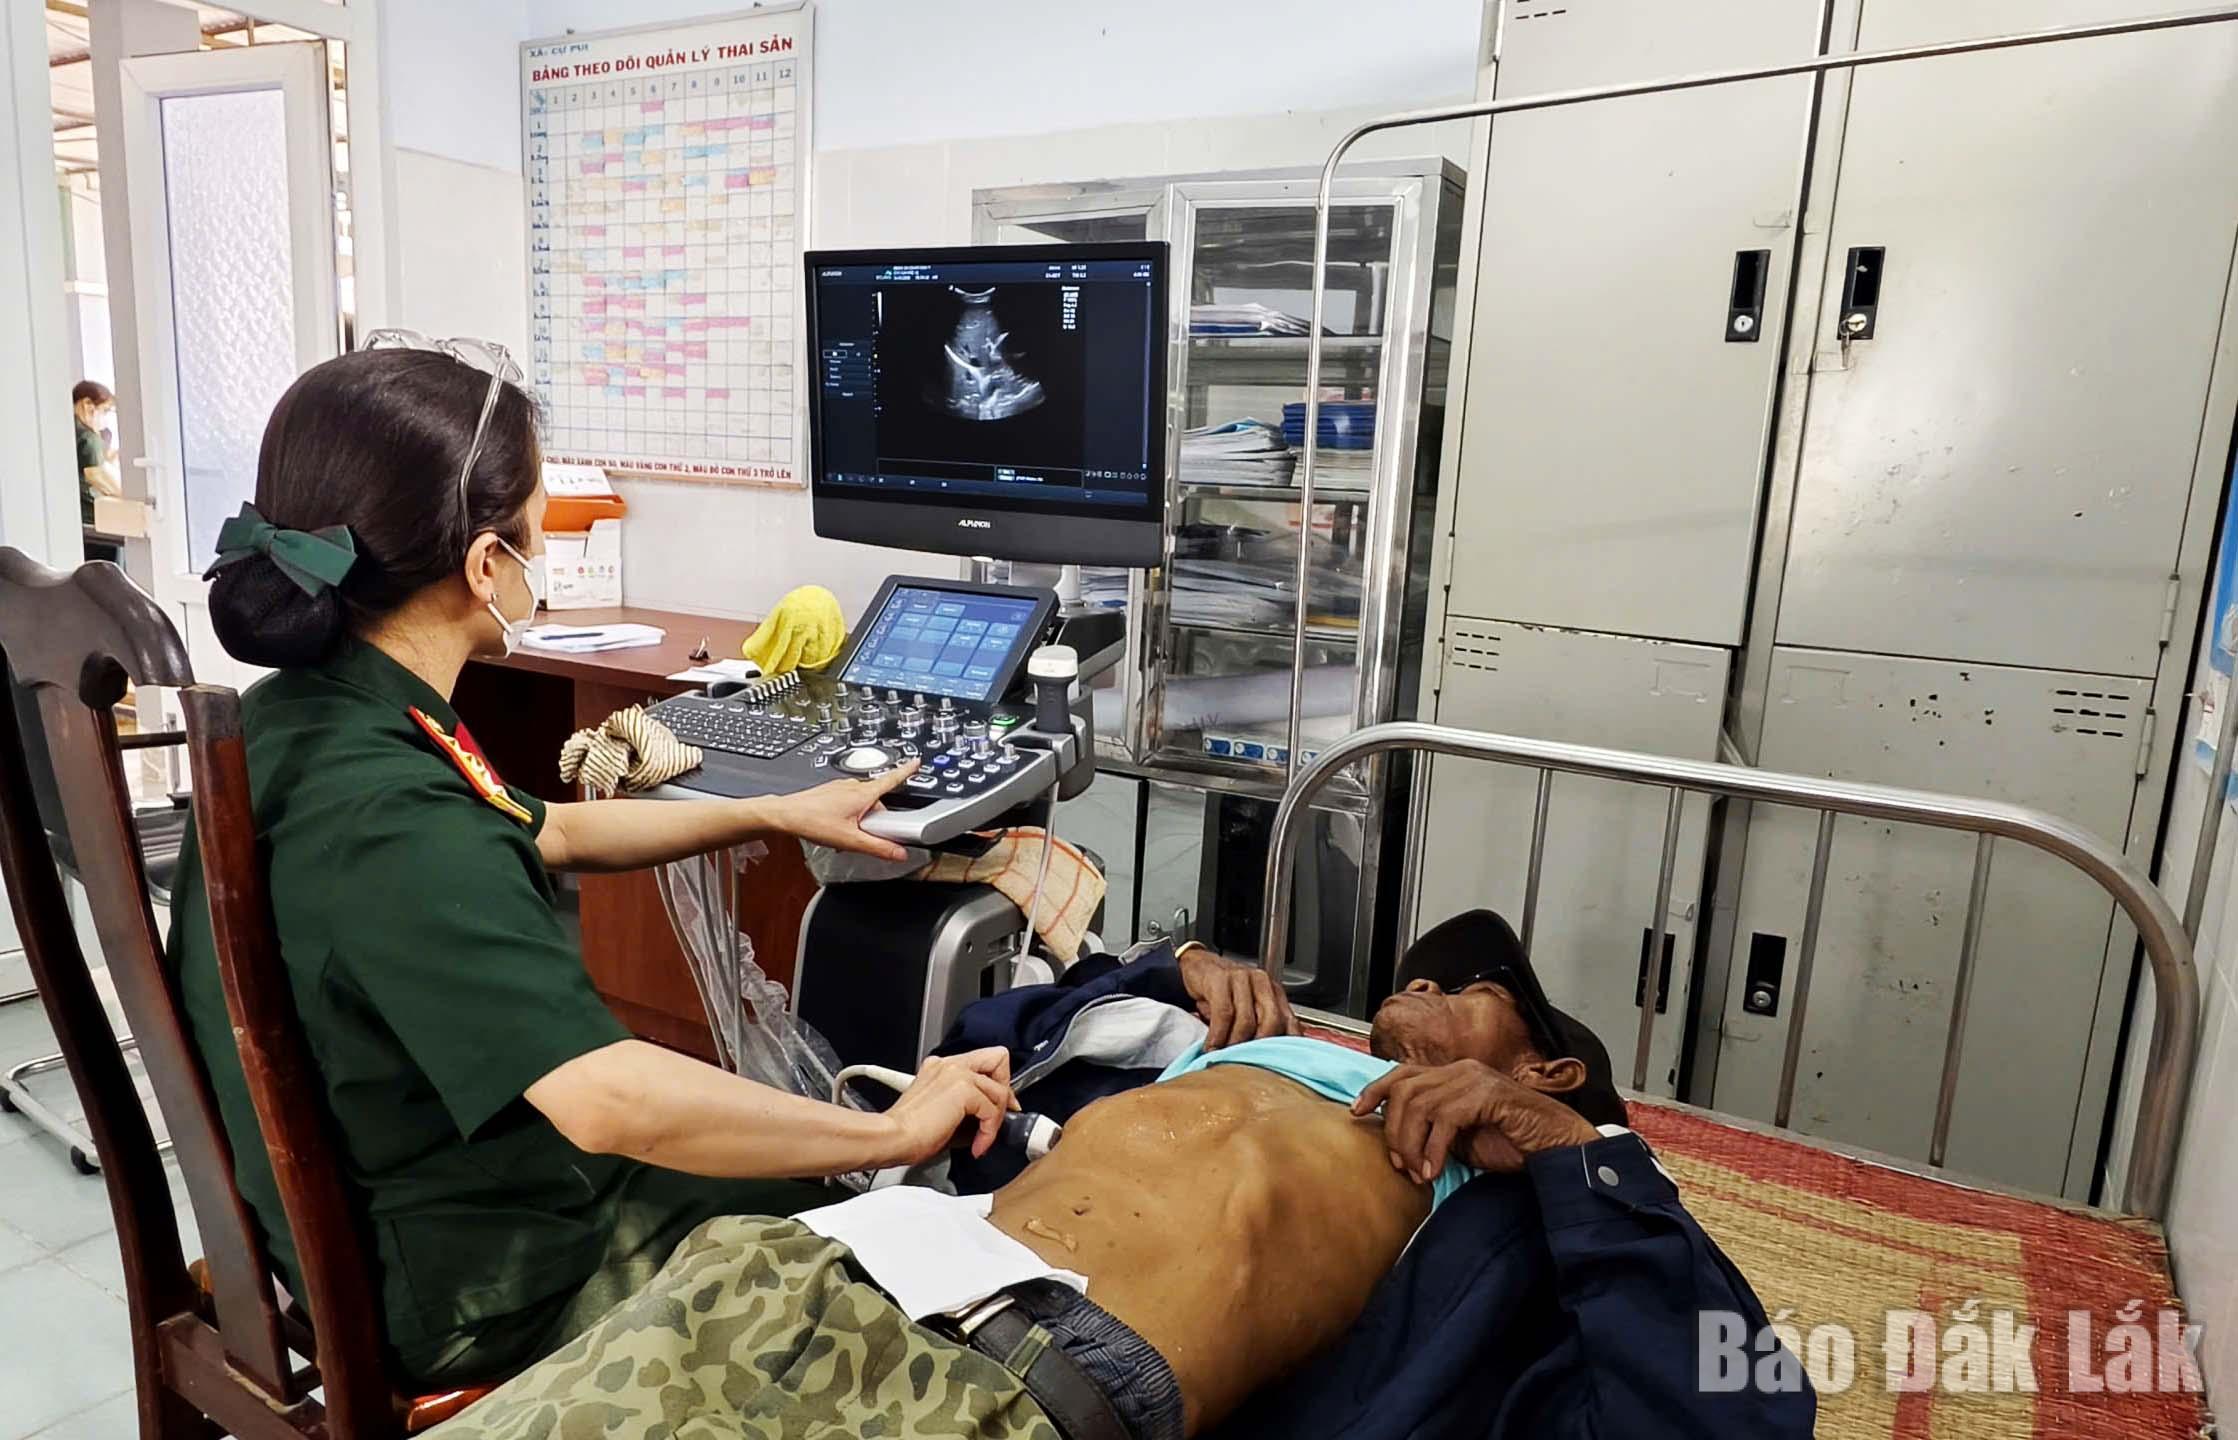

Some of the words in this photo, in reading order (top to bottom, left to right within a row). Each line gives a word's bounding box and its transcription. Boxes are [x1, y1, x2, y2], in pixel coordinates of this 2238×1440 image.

[532, 64, 569, 82] BẢNG
[574, 61, 610, 77] THEO
[645, 48, 686, 69] QUẢN
[692, 44, 710, 63] LÝ
[717, 42, 754, 60] THAI
[760, 34, 792, 54] SẢN
[756, 71, 767, 81] 11
[779, 68, 792, 79] 12
[721, 465, 735, 475] CON
[760, 466, 775, 478] TRỞ
[777, 468, 791, 479] LÊN
